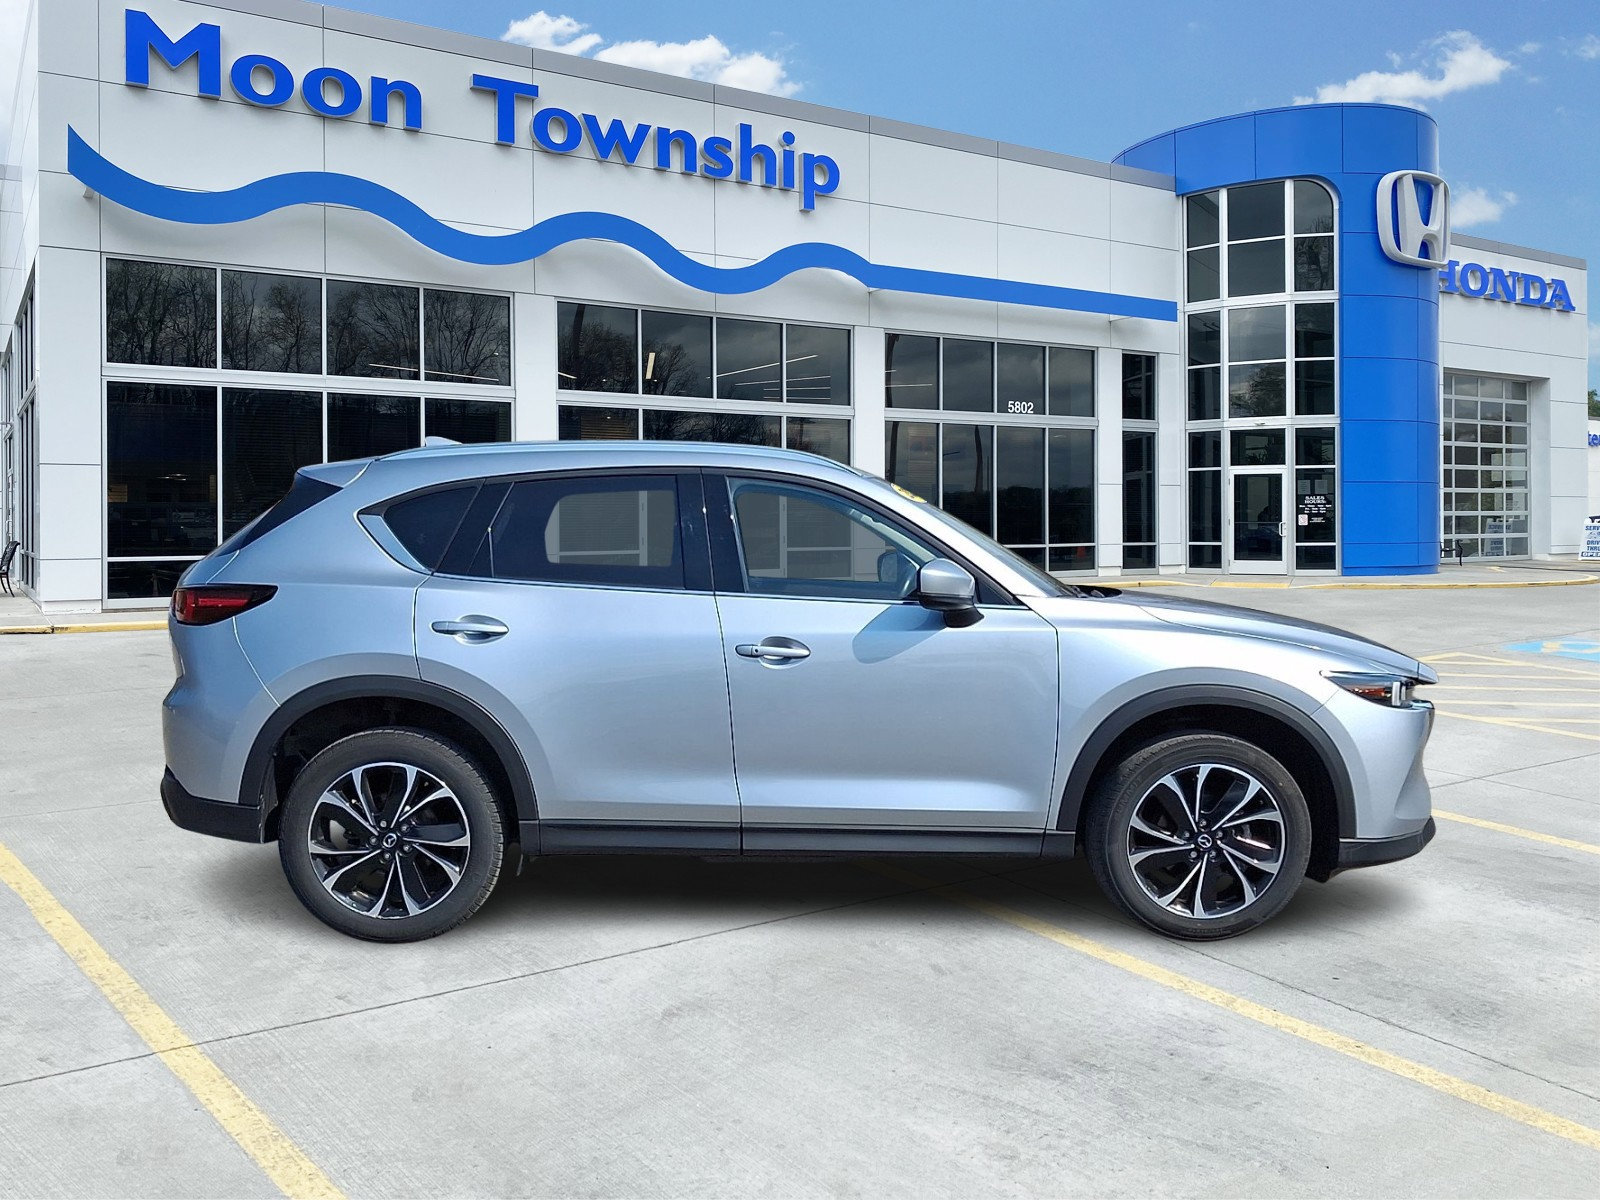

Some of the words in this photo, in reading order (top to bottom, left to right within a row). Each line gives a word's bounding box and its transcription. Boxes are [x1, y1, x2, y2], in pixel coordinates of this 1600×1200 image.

[125, 9, 422, 130] Moon
[470, 73, 841, 211] Township
[1007, 400, 1034, 414] 5802
